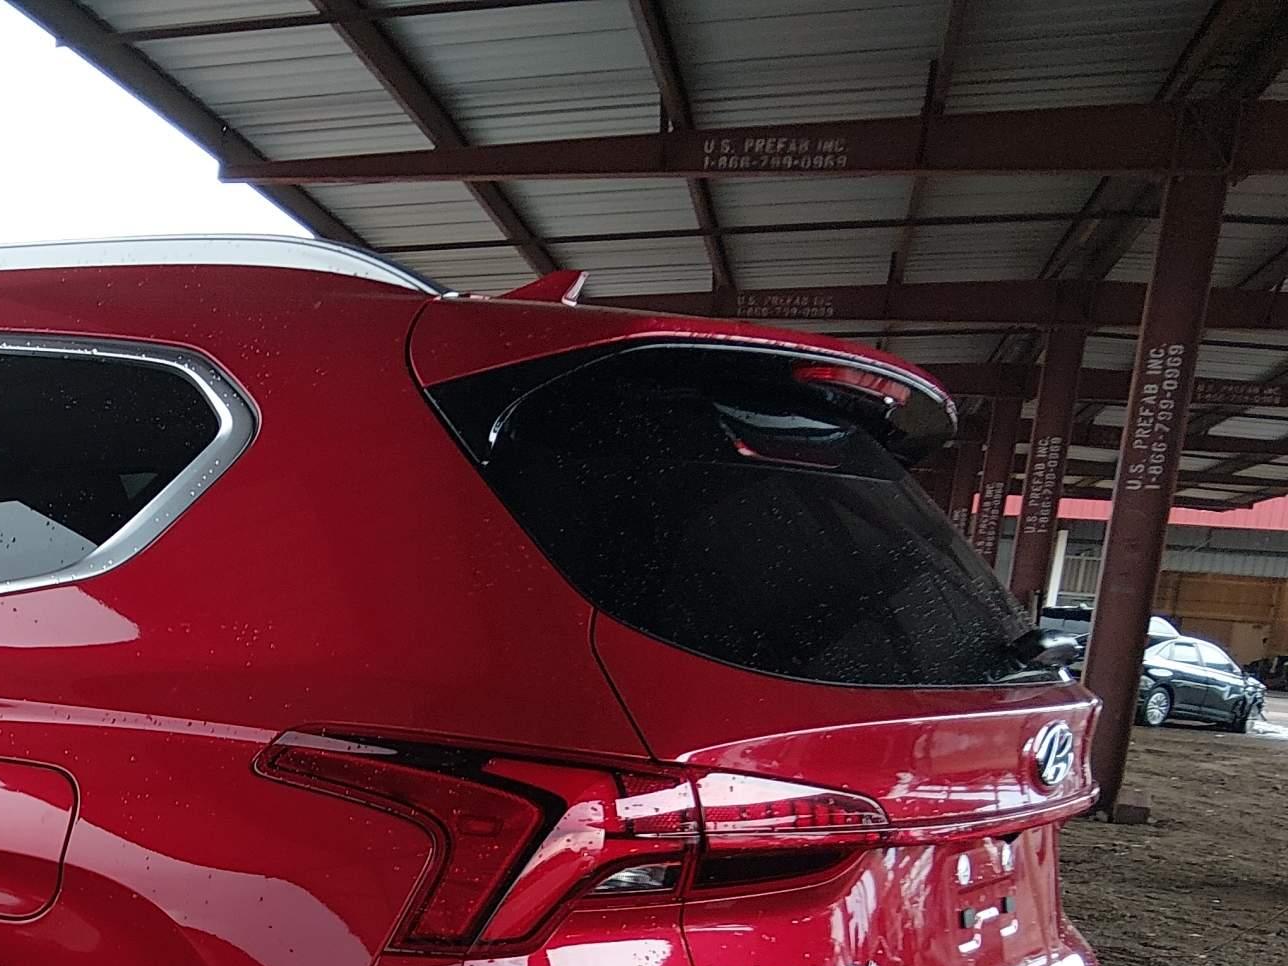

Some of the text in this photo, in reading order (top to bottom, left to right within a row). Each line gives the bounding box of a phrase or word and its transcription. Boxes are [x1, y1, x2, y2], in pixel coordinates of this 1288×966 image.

[744, 137, 810, 152] PREFAB
[1125, 342, 1168, 490] U.S. PREFAB INC.
[1143, 344, 1185, 491] 1-866-799-0969
